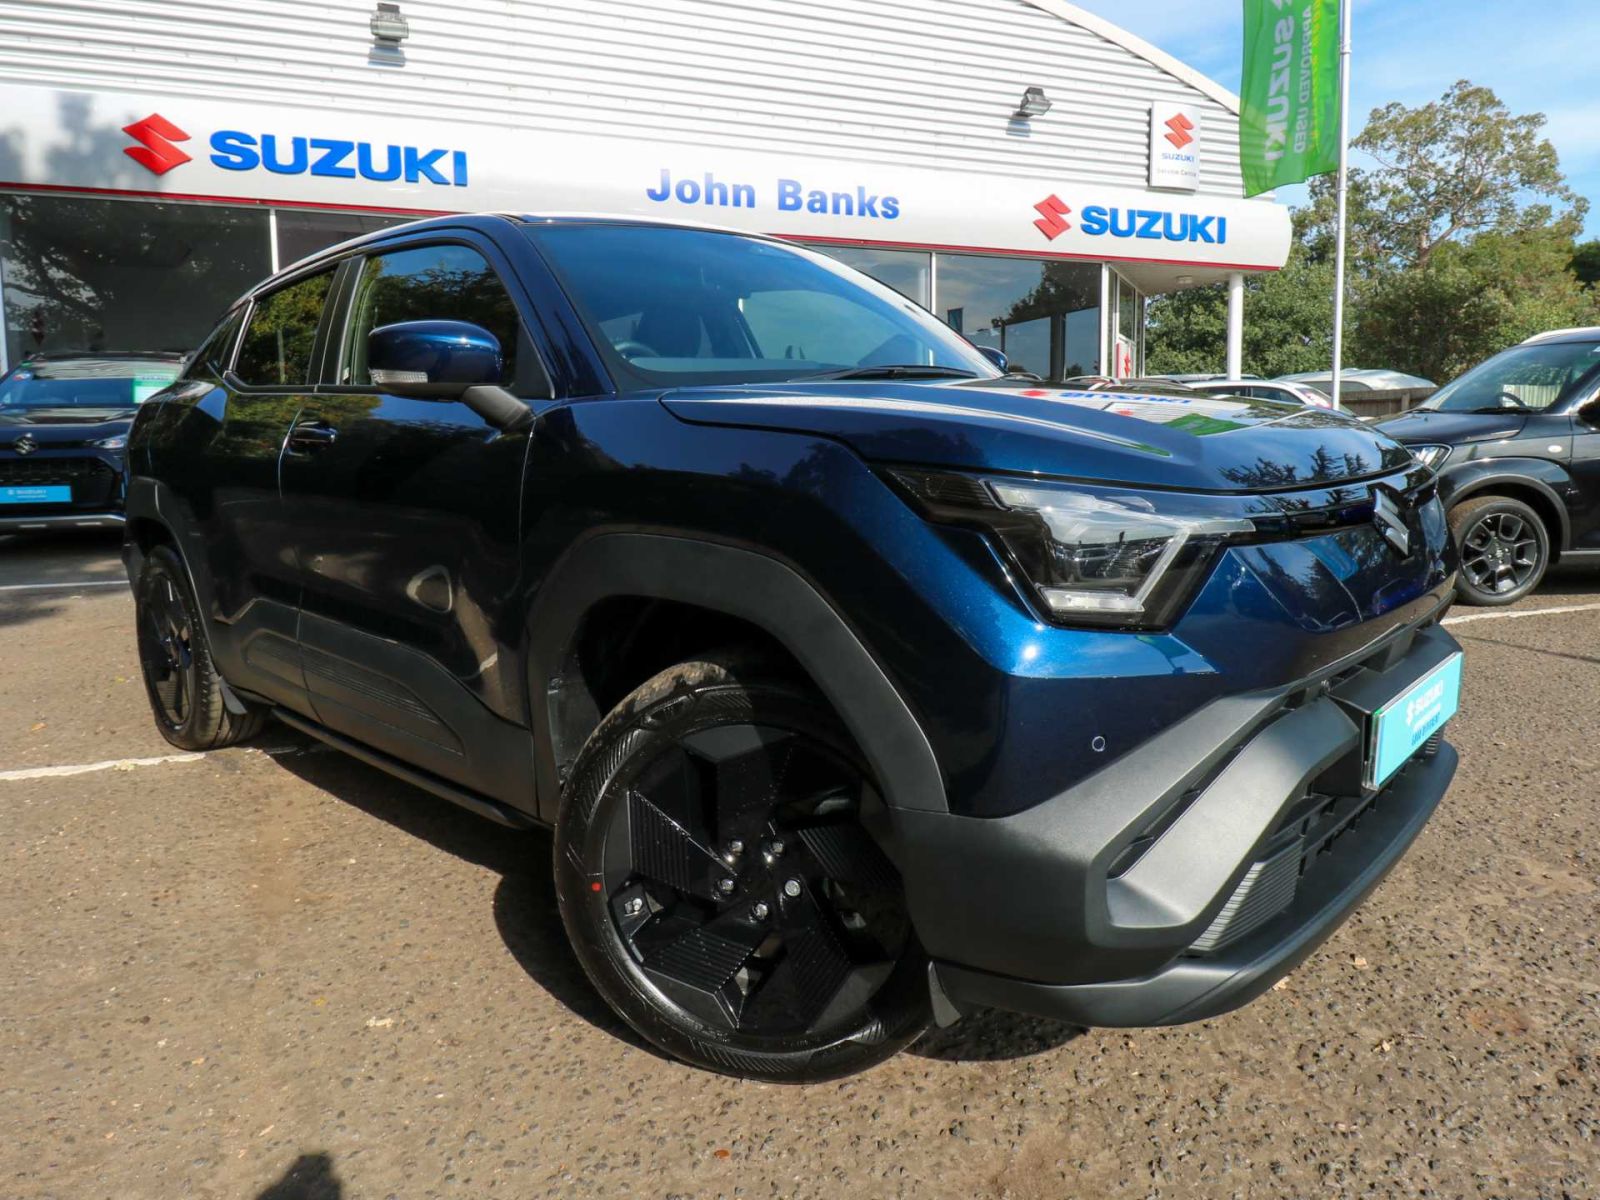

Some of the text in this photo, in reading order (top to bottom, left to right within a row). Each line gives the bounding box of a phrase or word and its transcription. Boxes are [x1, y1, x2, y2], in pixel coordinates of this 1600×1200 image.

[209, 129, 469, 188] SUZUKI
[1161, 152, 1195, 164] SUZUKI
[646, 168, 900, 220] John Banks
[1080, 204, 1227, 245] SUZUKI
